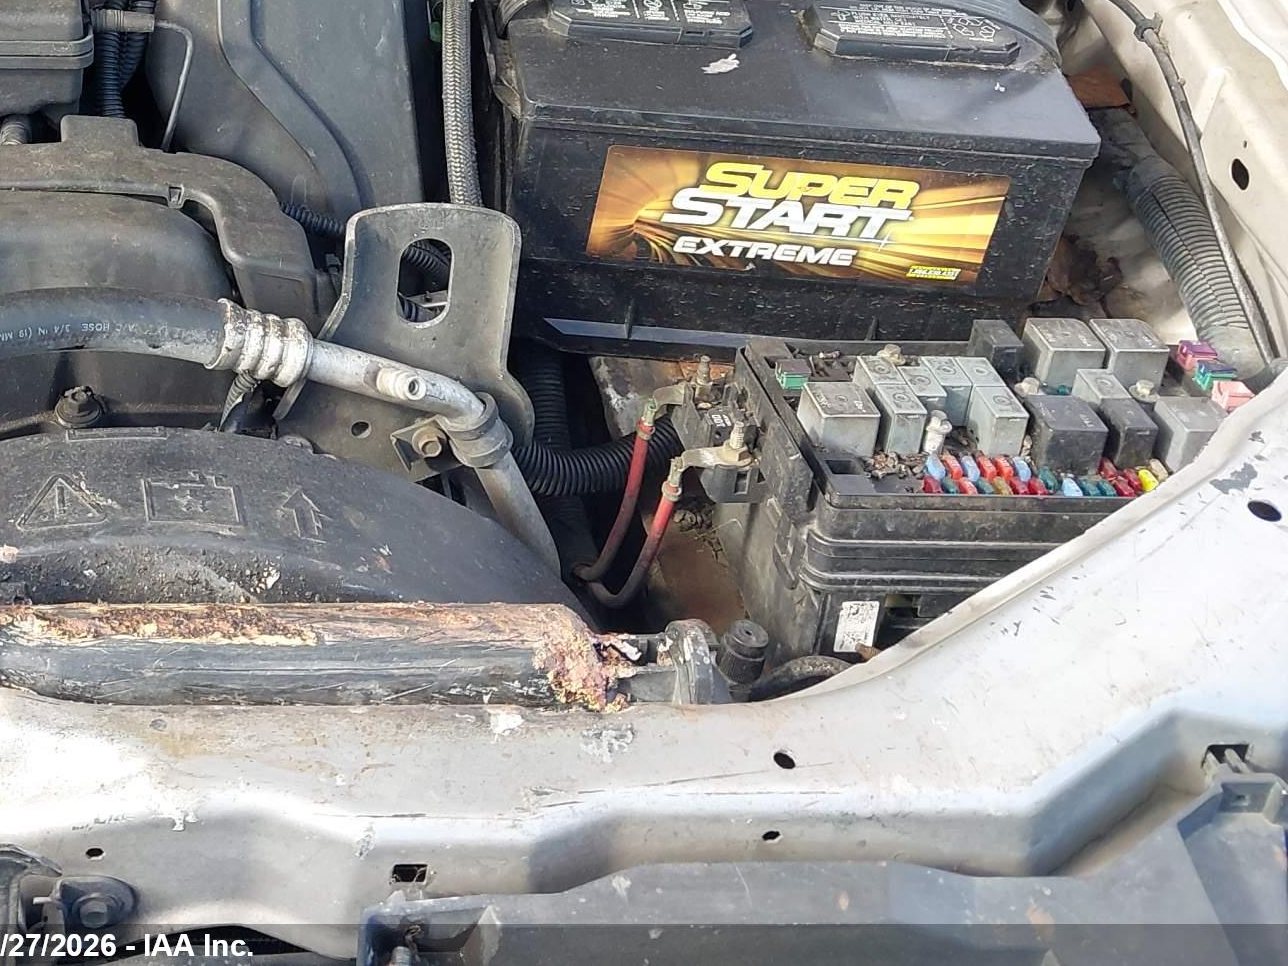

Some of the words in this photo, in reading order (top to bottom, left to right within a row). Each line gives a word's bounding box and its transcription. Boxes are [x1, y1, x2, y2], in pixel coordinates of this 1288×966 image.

[699, 162, 920, 210] SUPER
[661, 187, 913, 239] START
[673, 236, 858, 266] EXTREME
[81, 322, 110, 332] HOSE
